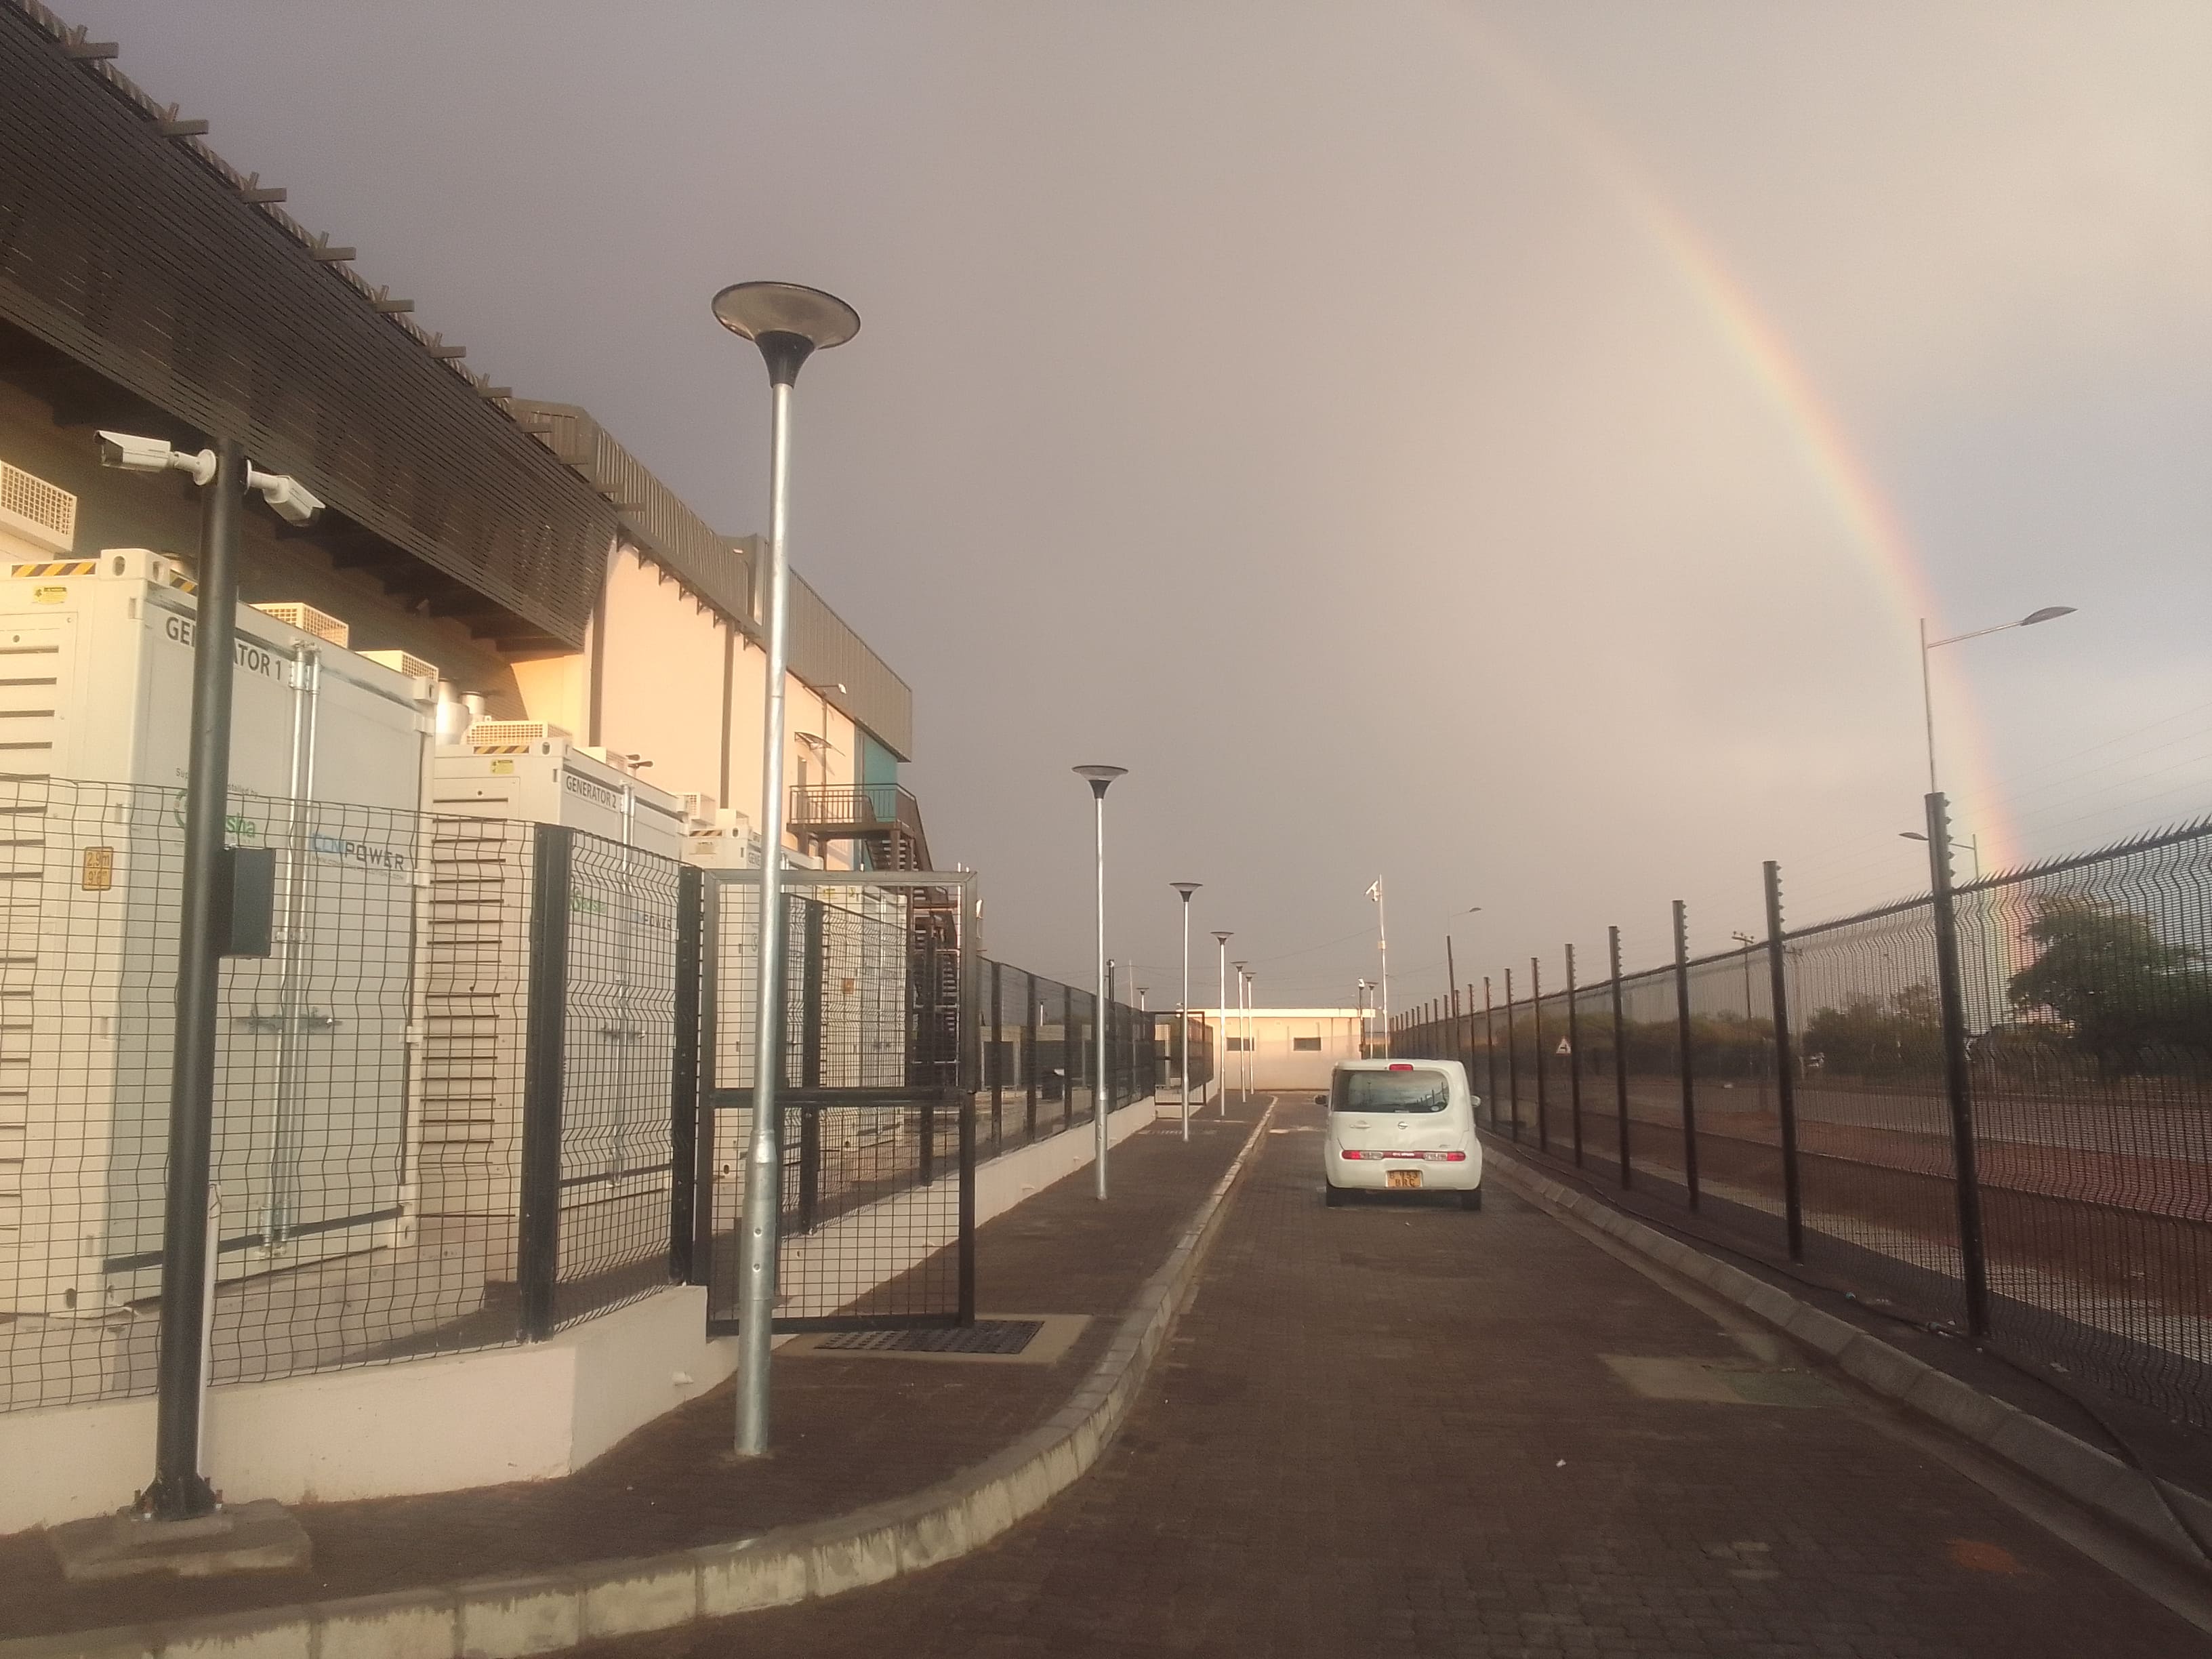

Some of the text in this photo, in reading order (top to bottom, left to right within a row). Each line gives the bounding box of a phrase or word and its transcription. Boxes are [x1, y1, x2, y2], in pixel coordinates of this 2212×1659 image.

[275, 659, 281, 680] 1
[566, 775, 617, 808] GENERATOR 2
